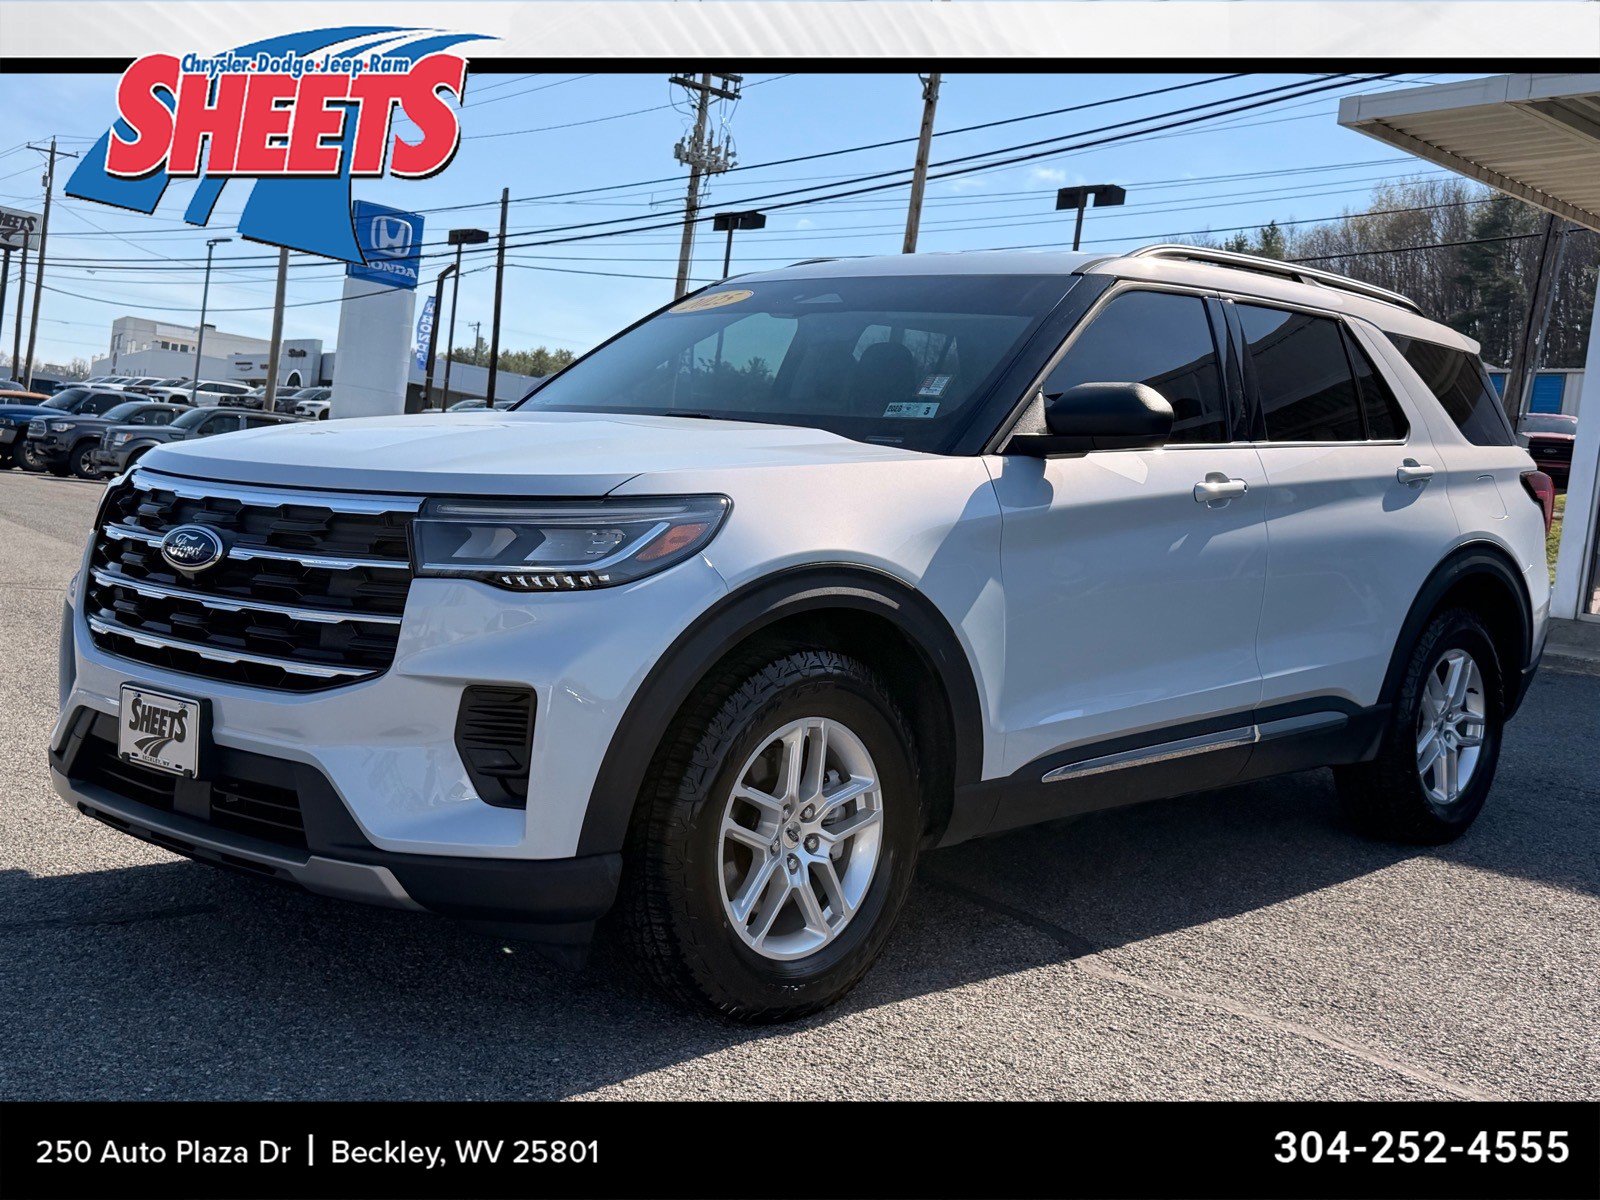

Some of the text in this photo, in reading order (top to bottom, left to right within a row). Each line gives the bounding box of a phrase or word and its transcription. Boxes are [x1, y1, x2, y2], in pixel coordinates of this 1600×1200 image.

[366, 261, 417, 279] ONDA
[167, 533, 205, 558] Ford
[129, 698, 188, 743] SHEETS
